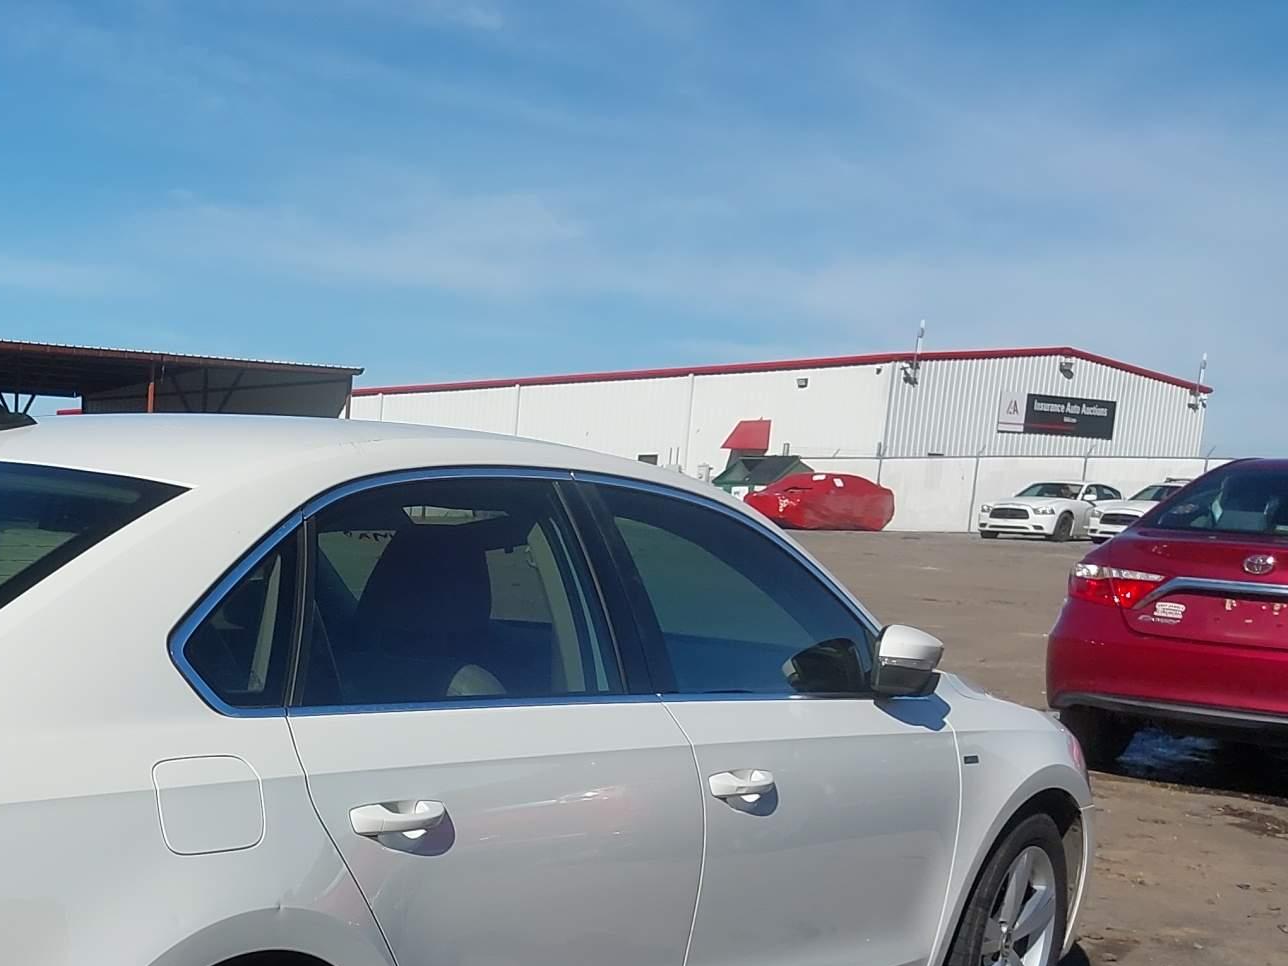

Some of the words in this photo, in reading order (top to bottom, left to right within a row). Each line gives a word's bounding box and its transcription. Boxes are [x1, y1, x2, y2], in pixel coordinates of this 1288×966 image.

[1033, 399, 1065, 413] Insurance
[1065, 402, 1081, 415] Auto
[1081, 403, 1108, 417] Auctions
